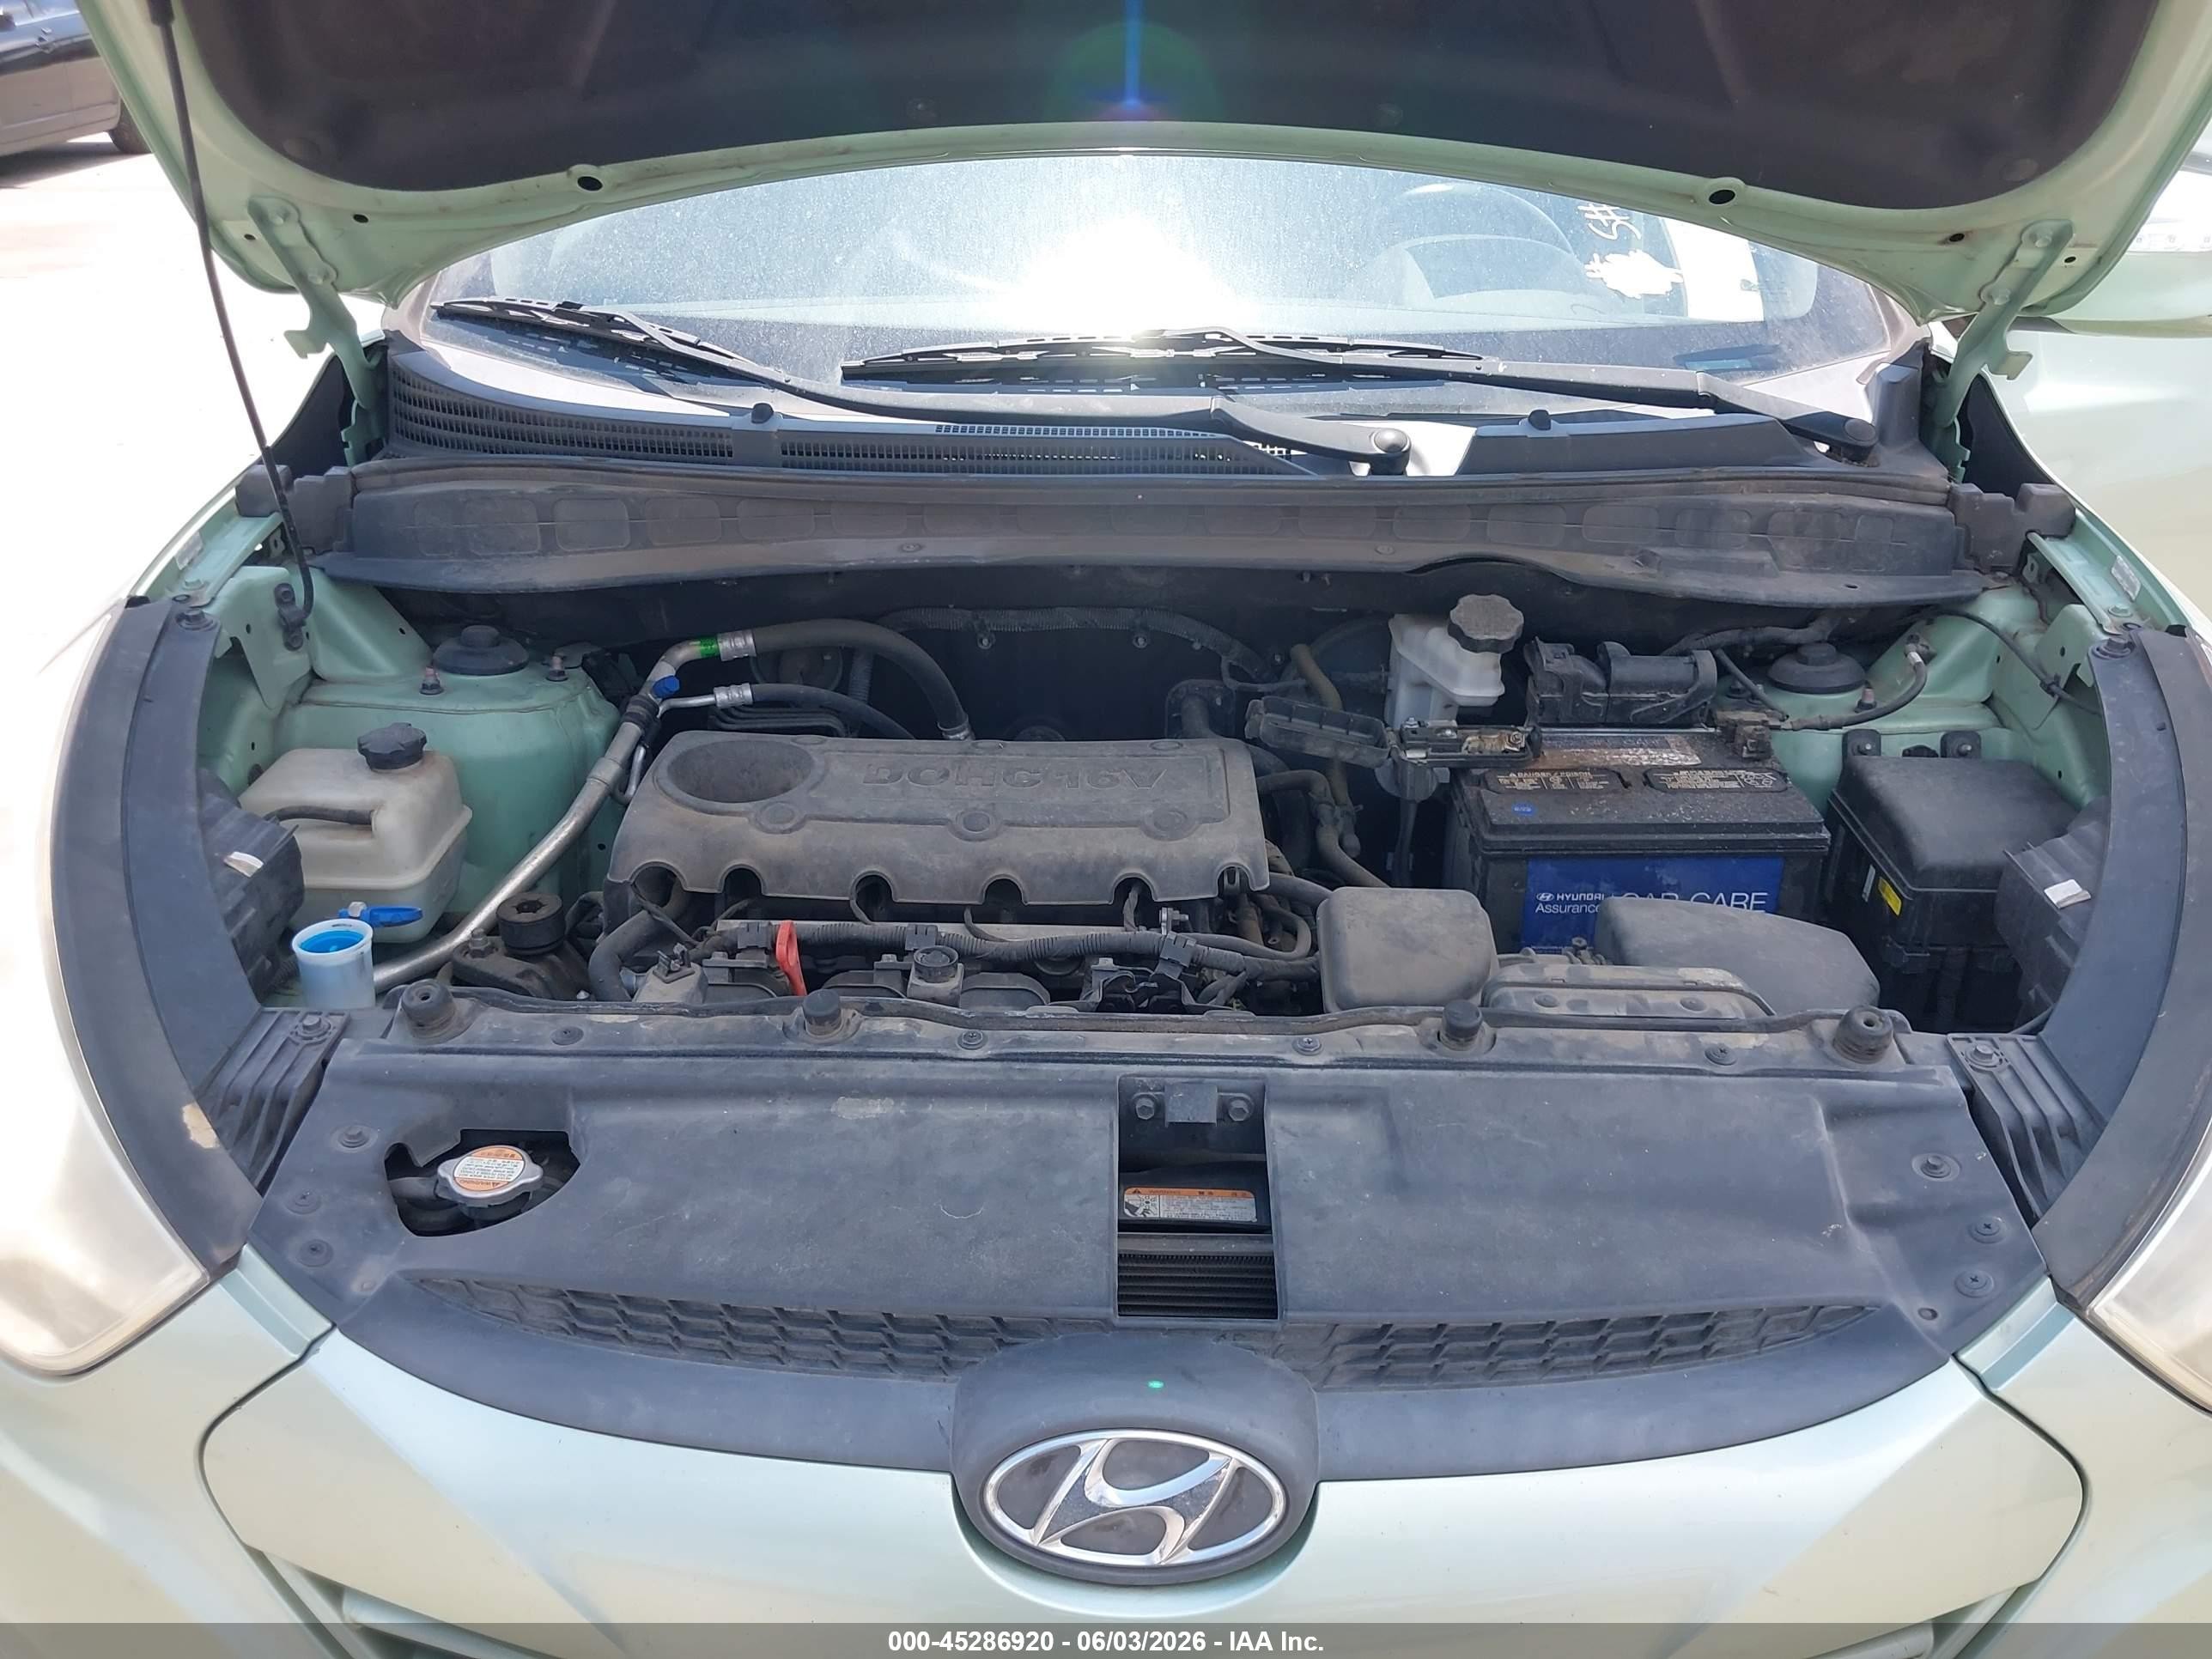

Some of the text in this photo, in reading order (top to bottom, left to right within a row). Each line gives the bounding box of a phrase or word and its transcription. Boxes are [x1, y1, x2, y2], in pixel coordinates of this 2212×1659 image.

[862, 763, 1167, 790] DOHC 16V
[1556, 892, 1605, 902] HYUNDAI
